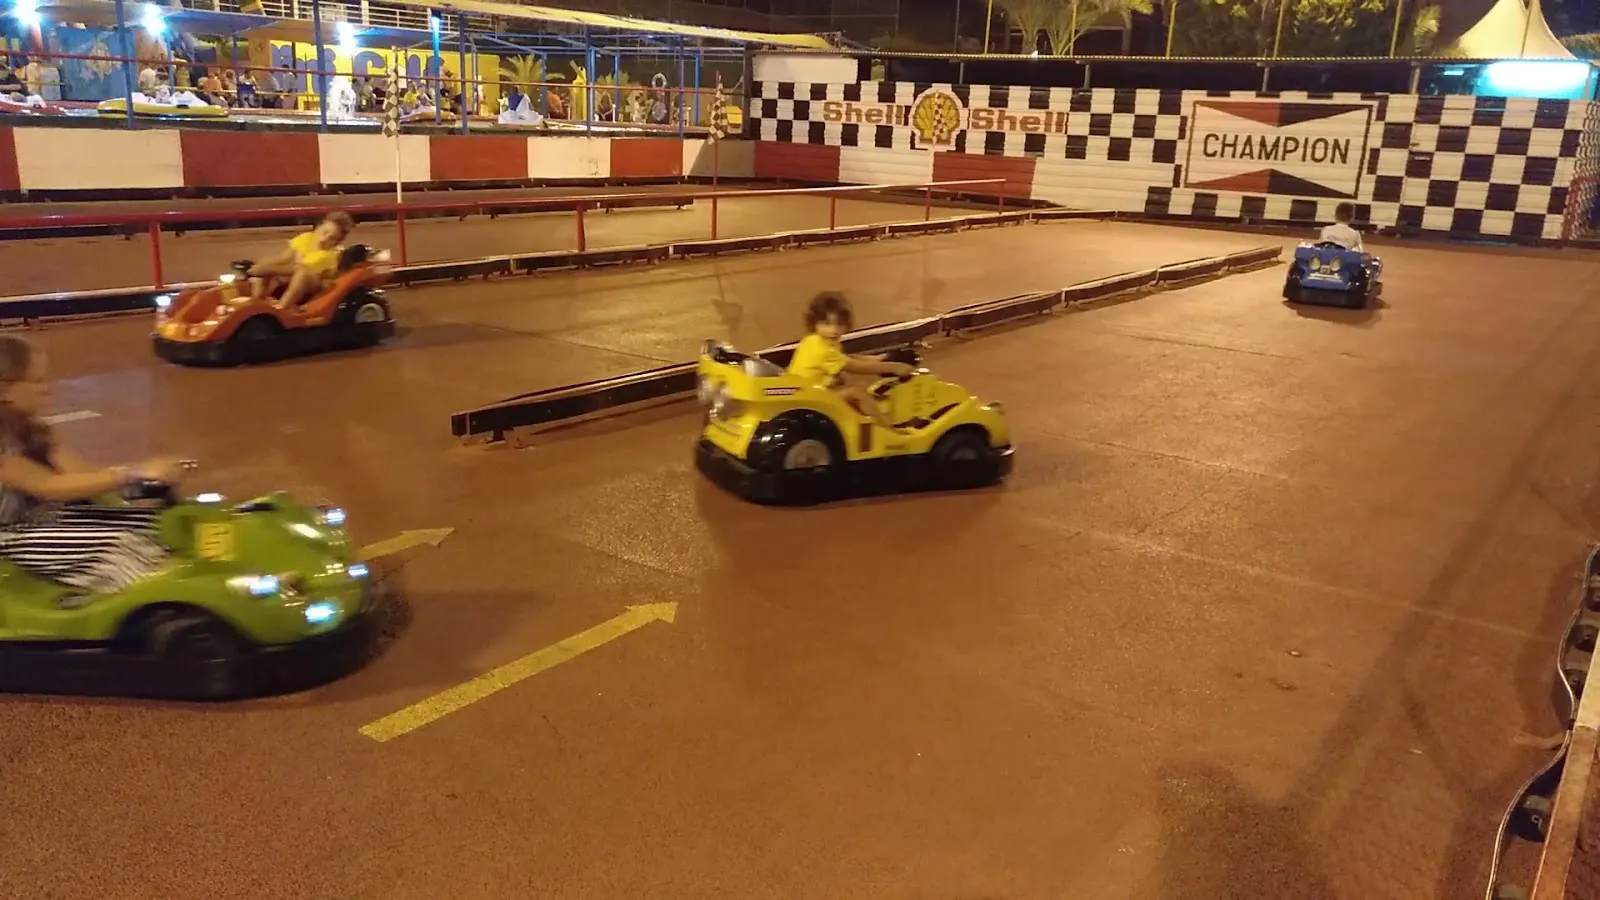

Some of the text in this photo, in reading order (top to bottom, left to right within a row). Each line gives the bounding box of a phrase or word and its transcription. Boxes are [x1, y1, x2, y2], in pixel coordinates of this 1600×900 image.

[823, 101, 1066, 133] Shell Shell
[1203, 133, 1350, 164] CHAMPION
